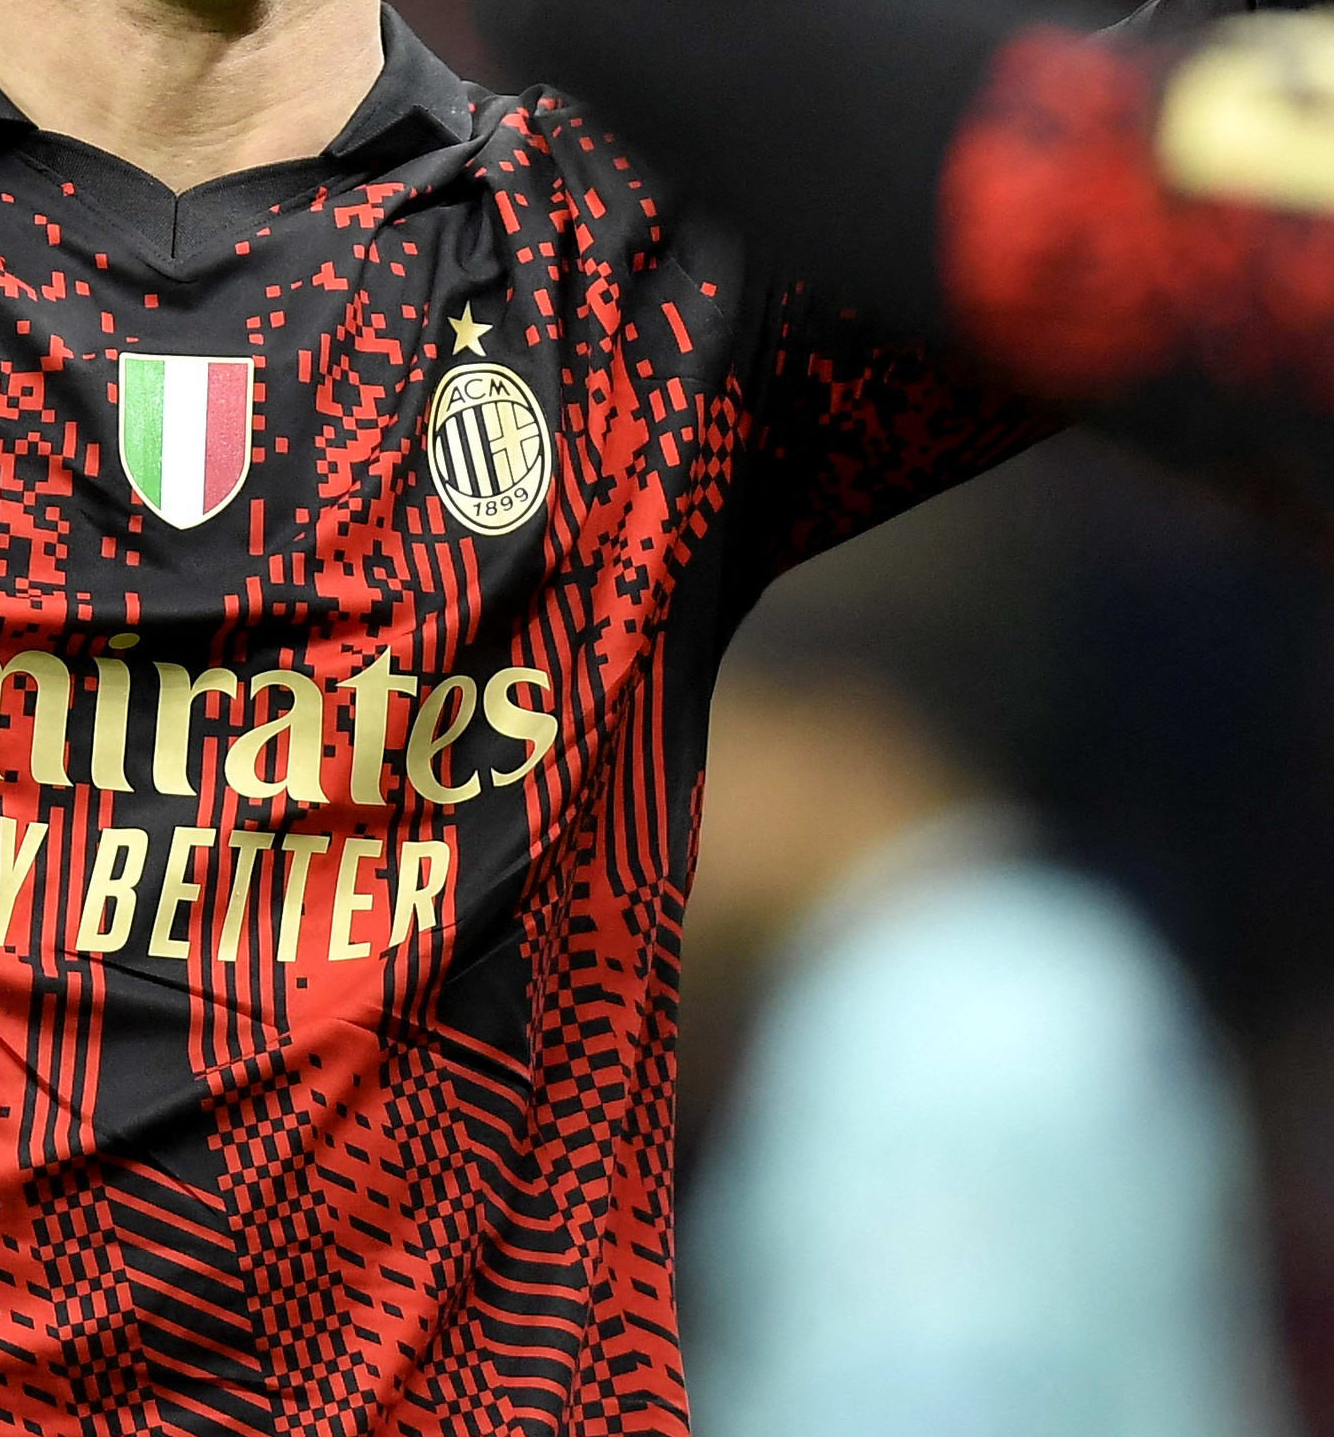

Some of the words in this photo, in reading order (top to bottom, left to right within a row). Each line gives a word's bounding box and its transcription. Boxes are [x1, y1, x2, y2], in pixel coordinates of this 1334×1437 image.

[446, 378, 511, 412] ACM
[473, 487, 529, 517] 1899
[75, 826, 452, 964] BETTER
